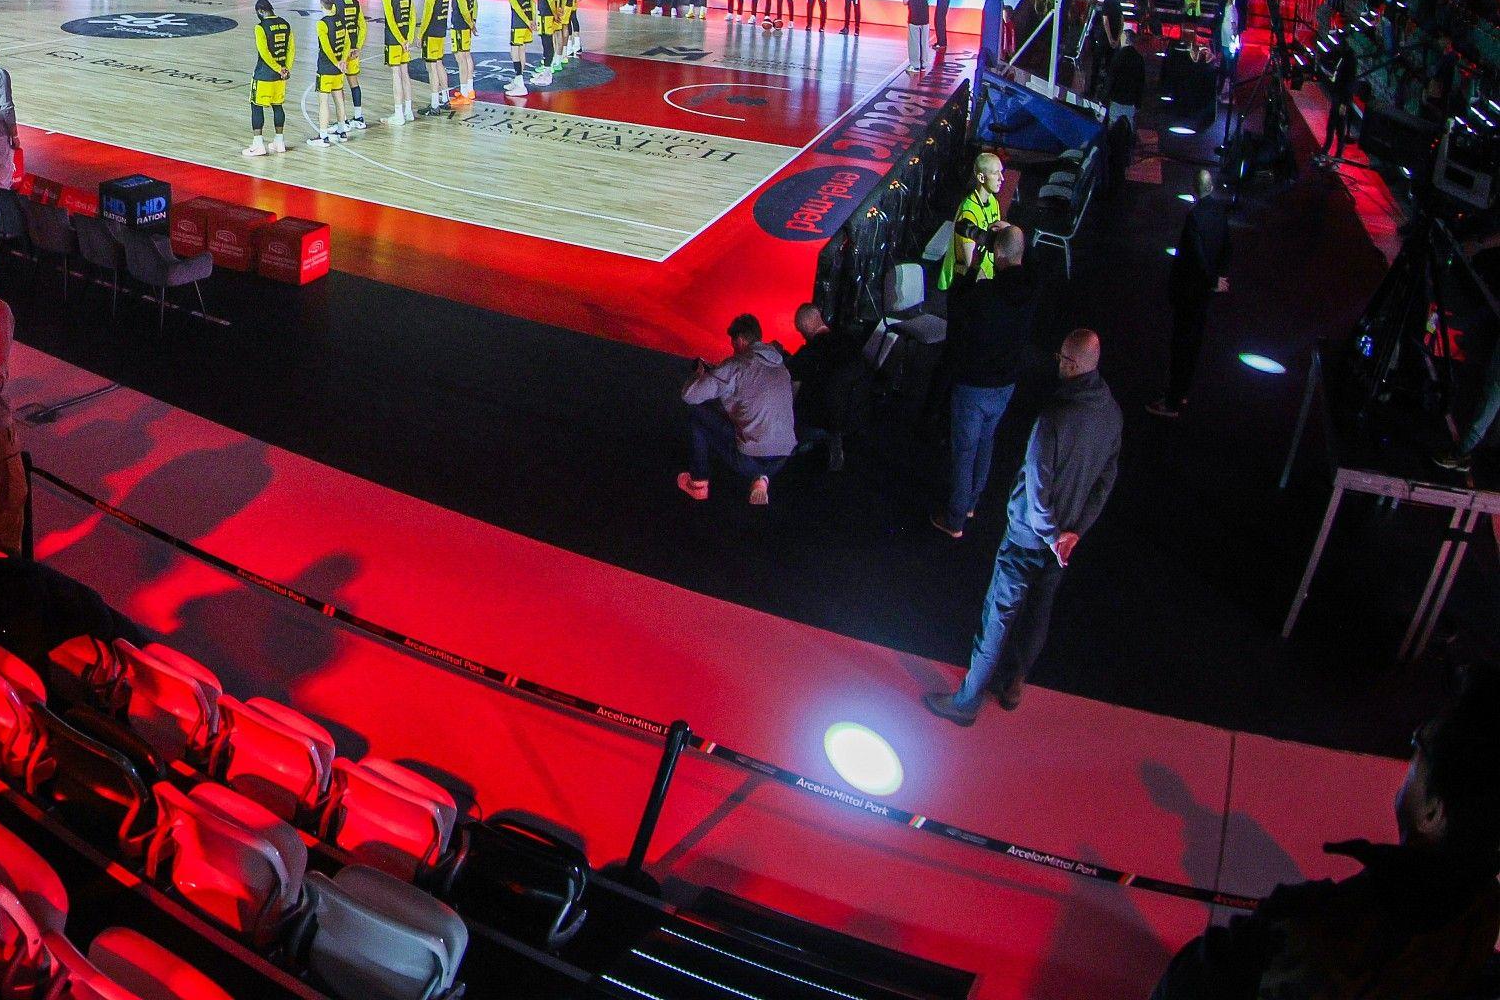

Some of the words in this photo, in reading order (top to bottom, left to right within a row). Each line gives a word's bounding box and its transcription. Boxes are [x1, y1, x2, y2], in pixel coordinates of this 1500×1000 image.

[832, 89, 948, 159] Betclic
[136, 211, 167, 225] RATION
[785, 170, 861, 235] enel-med
[403, 637, 463, 667] ArcelorMittal
[464, 660, 485, 675] Park
[596, 706, 662, 734] ArcelorMittal
[795, 776, 864, 808] ArcelorMittal
[864, 800, 890, 816] Park
[1006, 845, 1074, 871] ArcelorMittal
[1075, 863, 1098, 877] Park
